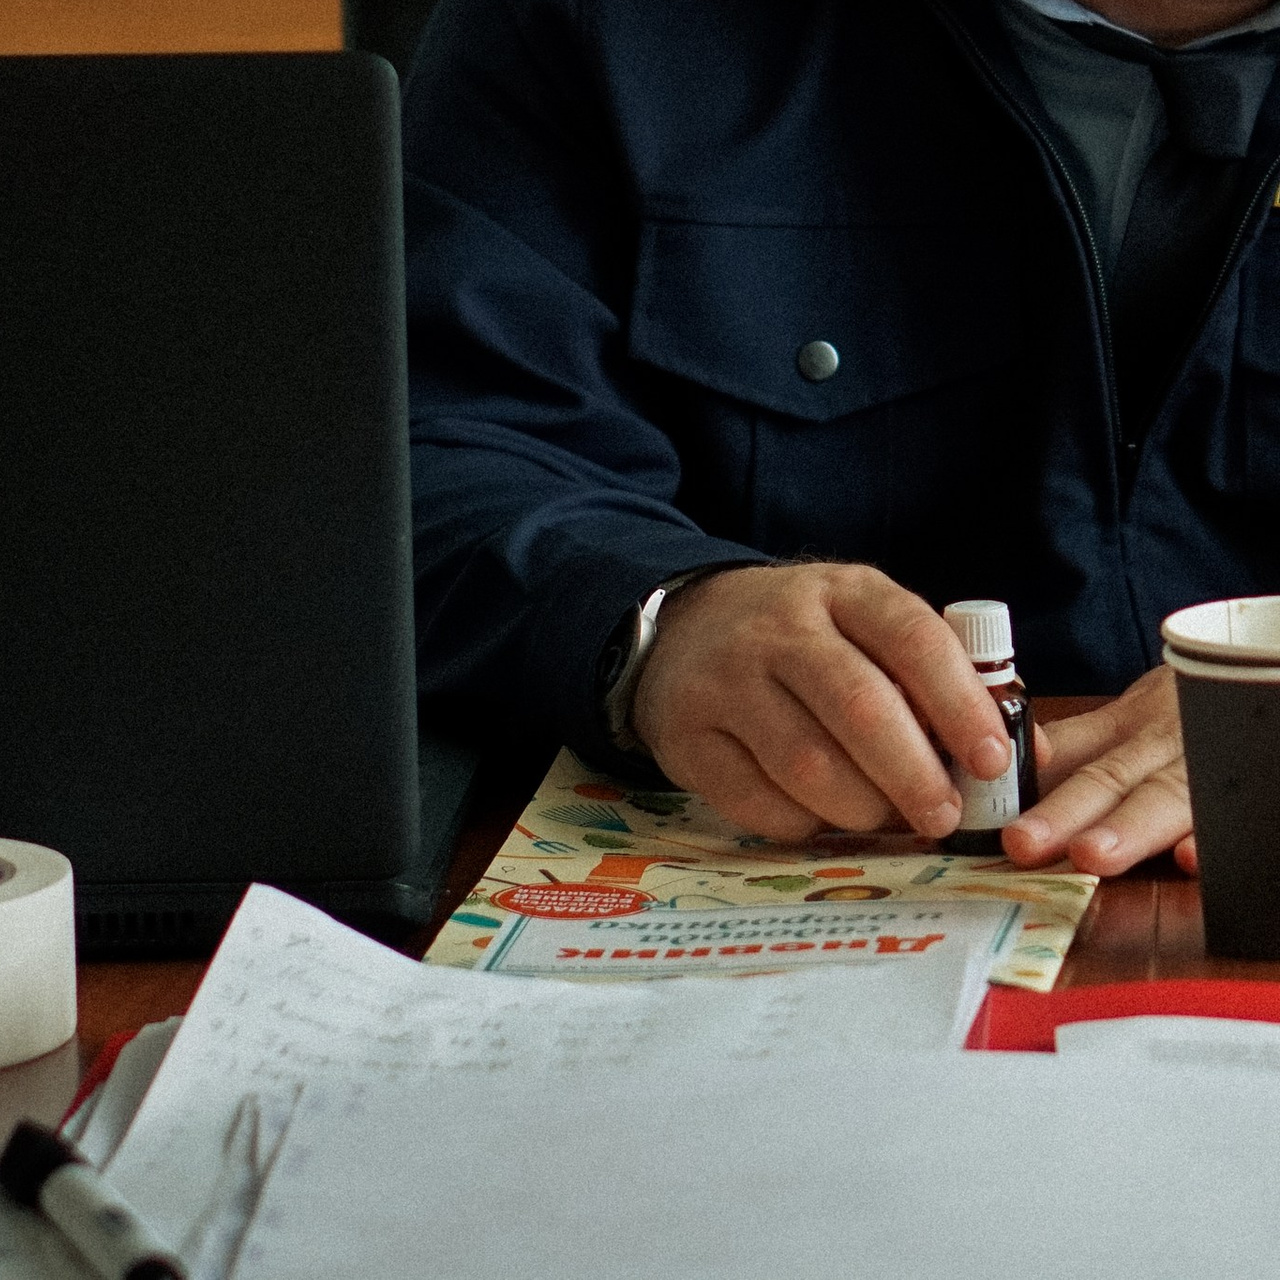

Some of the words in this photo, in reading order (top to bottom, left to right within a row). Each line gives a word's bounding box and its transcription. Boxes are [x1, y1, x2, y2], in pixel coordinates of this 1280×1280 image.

[588, 912, 898, 931] огородника
[913, 911, 944, 920] и
[637, 924, 881, 945] садовода
[555, 933, 947, 960] Дневник
